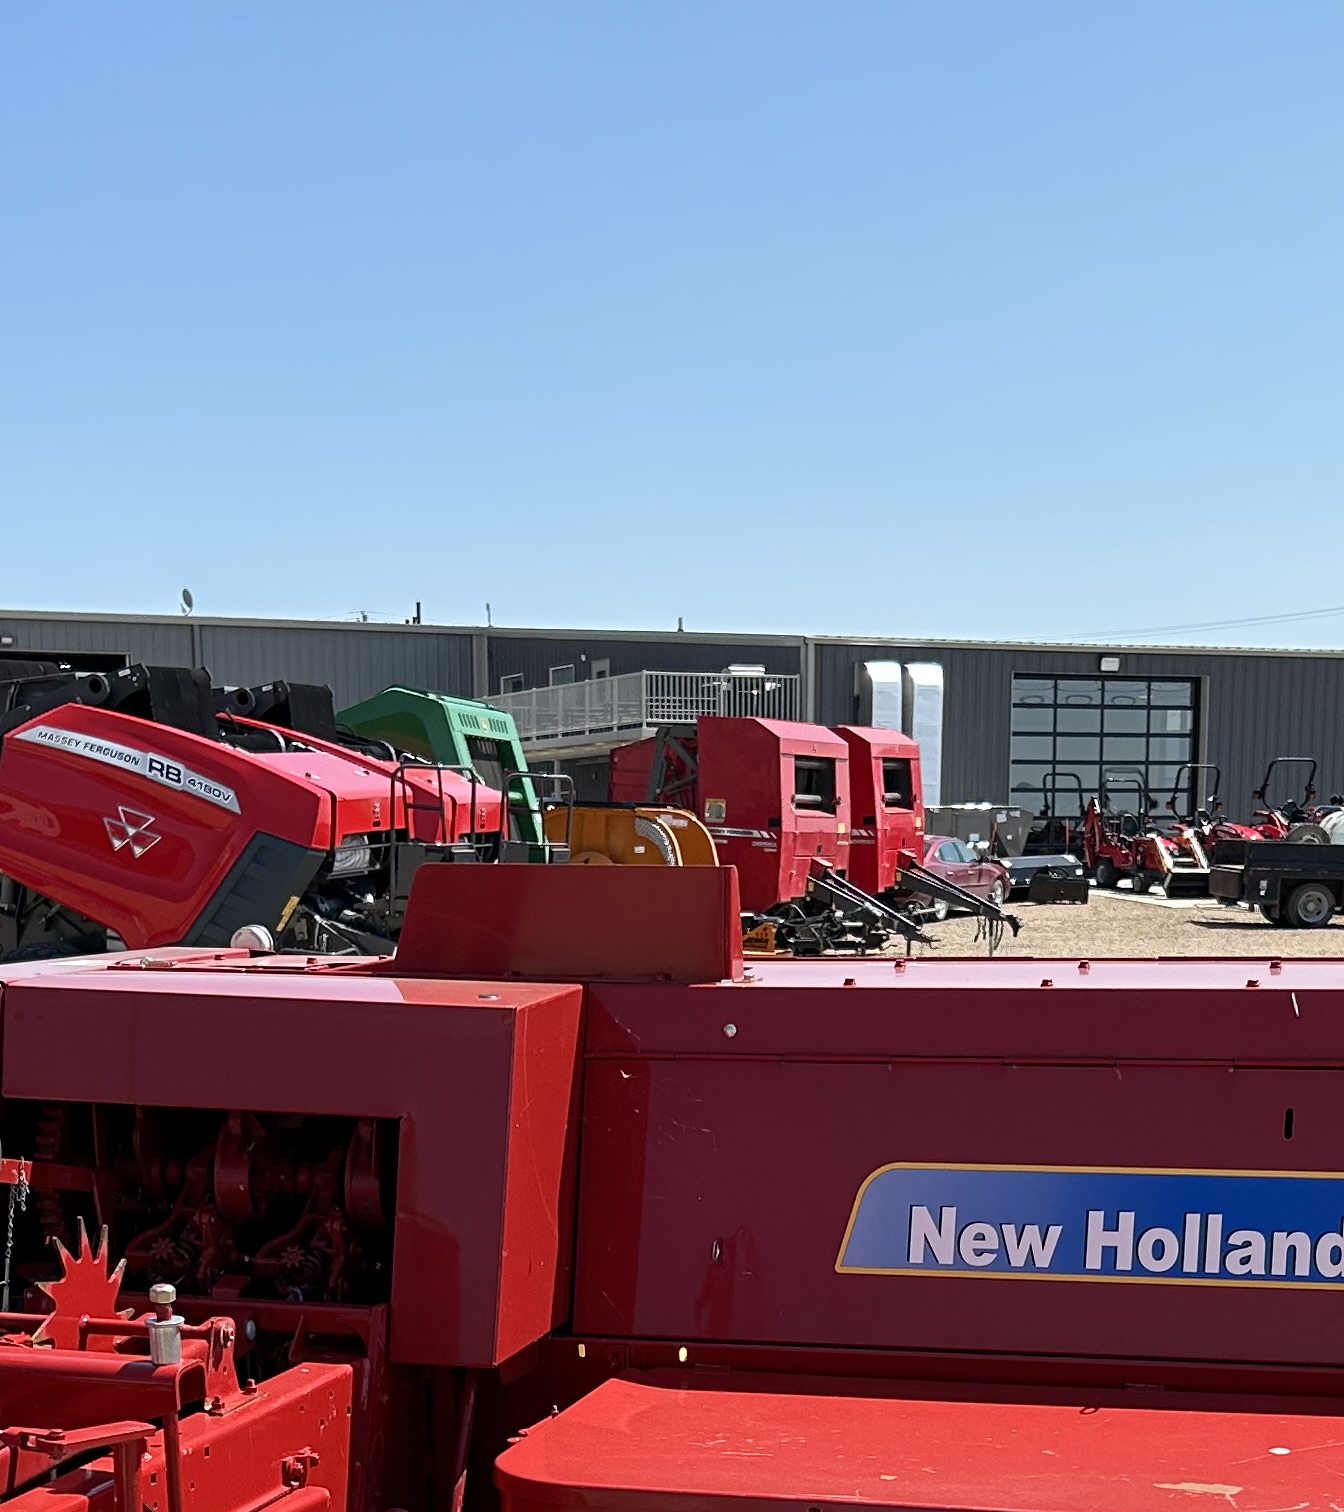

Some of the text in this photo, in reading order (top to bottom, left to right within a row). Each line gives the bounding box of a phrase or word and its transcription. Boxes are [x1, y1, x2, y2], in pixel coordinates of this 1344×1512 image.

[37, 731, 232, 802] MASSEY FERGUSON RB 4180V
[909, 1205, 1063, 1267] New
